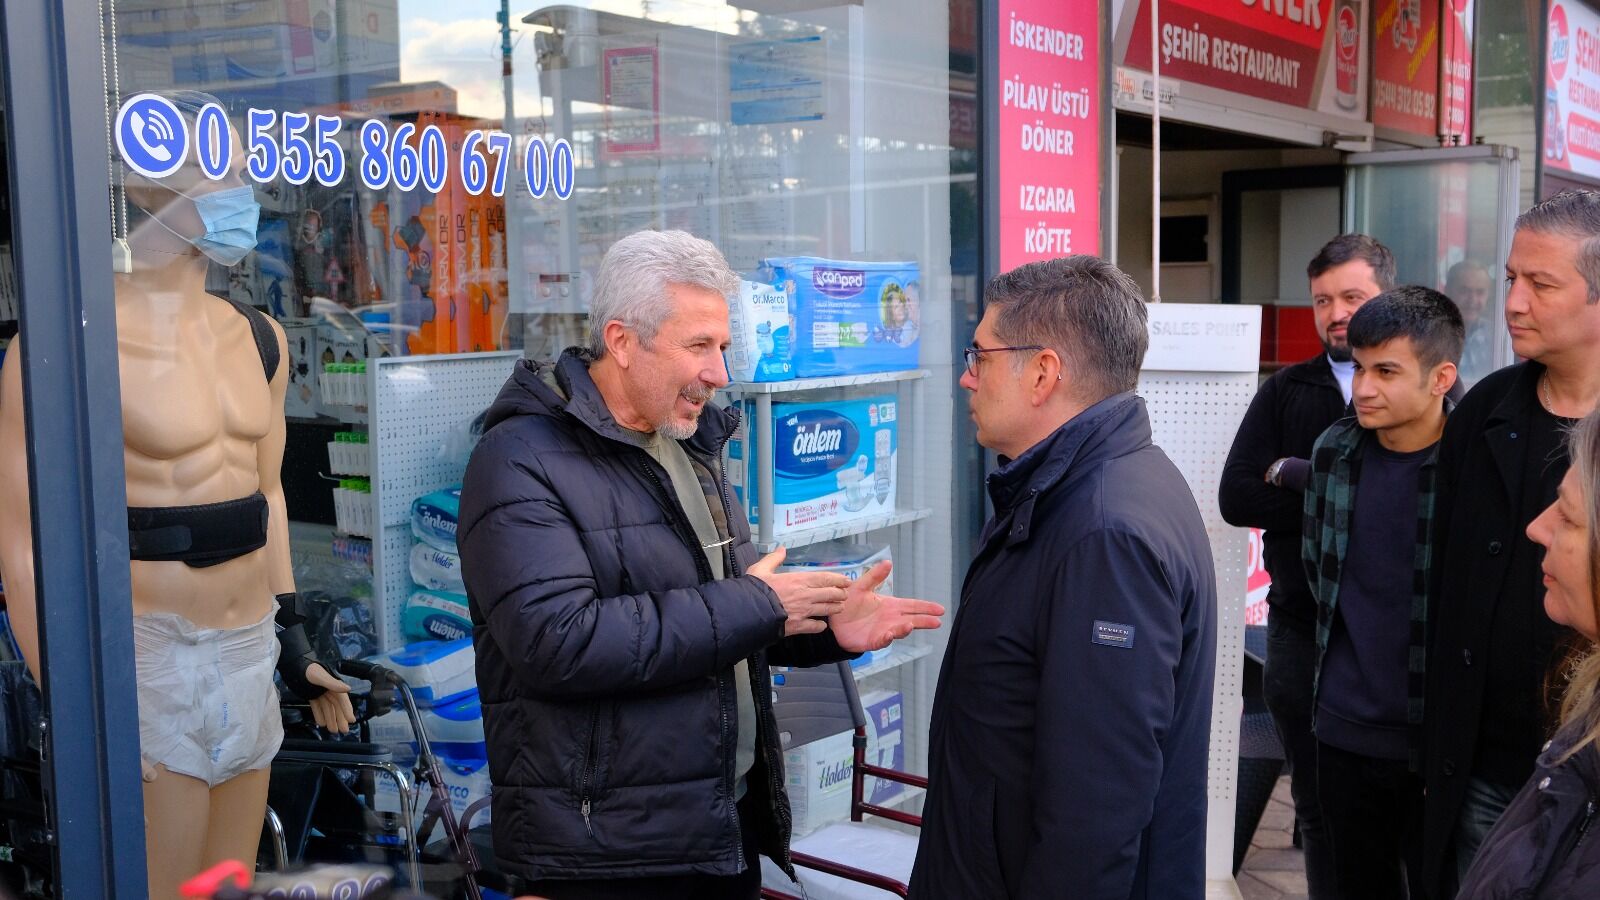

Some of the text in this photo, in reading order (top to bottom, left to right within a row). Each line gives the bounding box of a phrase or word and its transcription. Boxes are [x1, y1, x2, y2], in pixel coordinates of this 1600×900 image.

[1010, 11, 1083, 61] İSKENDER
[1163, 23, 1300, 89] ŞEHİR RESTAURANT
[1004, 74, 1048, 112] PİLAV
[1052, 82, 1089, 119] ÜSTÜ
[196, 103, 575, 200] 0 555 860 67 00
[1021, 120, 1074, 156] DÖNER
[1020, 185, 1075, 213] IZGARA
[440, 214, 449, 295] ARMOR
[457, 213, 466, 293] ARMOR
[1024, 222, 1071, 253] KÖFTE
[821, 270, 863, 290] canped
[1152, 321, 1248, 337] SALES POINT
[793, 422, 841, 456] önlem
